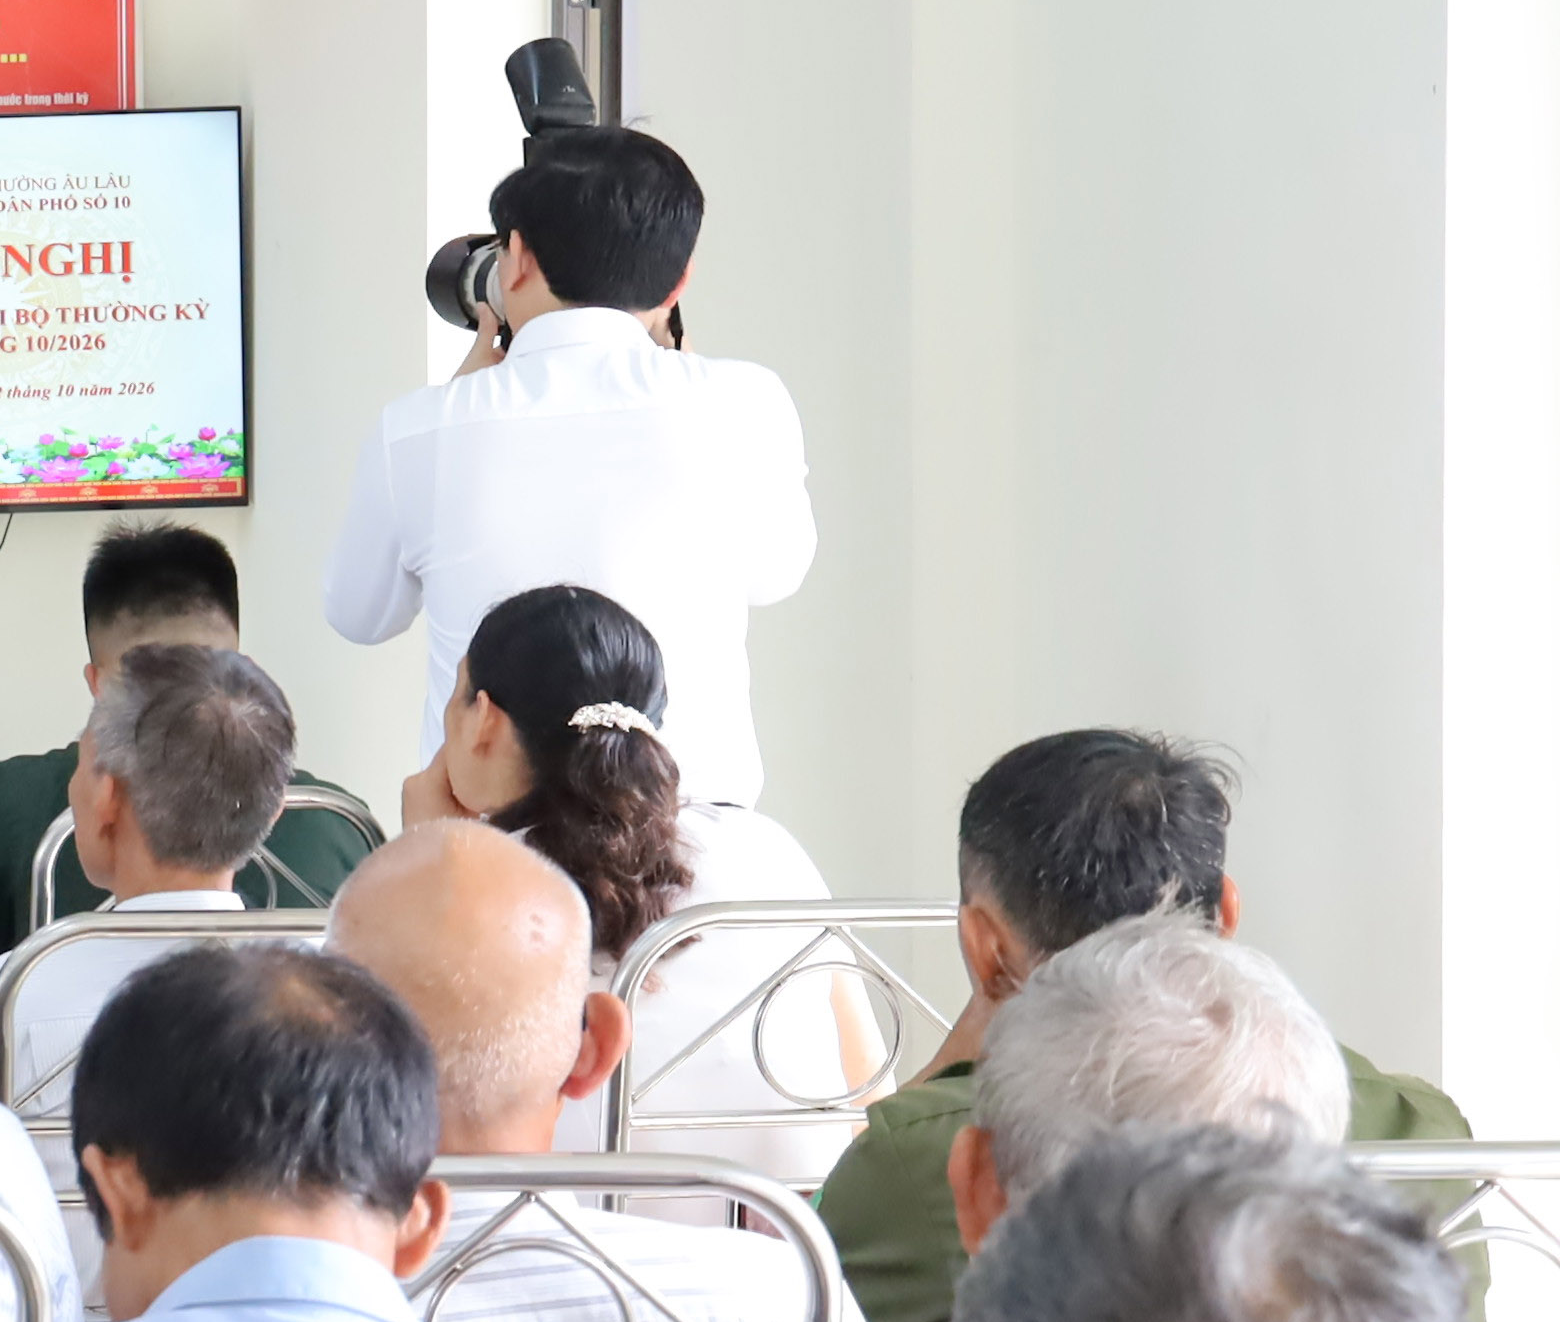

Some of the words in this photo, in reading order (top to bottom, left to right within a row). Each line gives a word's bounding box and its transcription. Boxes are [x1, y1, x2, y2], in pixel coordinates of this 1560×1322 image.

[0, 241, 135, 284] NGHỊ
[15, 305, 50, 329] BỘ
[55, 301, 167, 324] THƯỜNG
[175, 298, 210, 320] KỲ
[26, 334, 106, 351] 10/2026
[57, 384, 74, 397] 10
[118, 382, 155, 395] 2026
